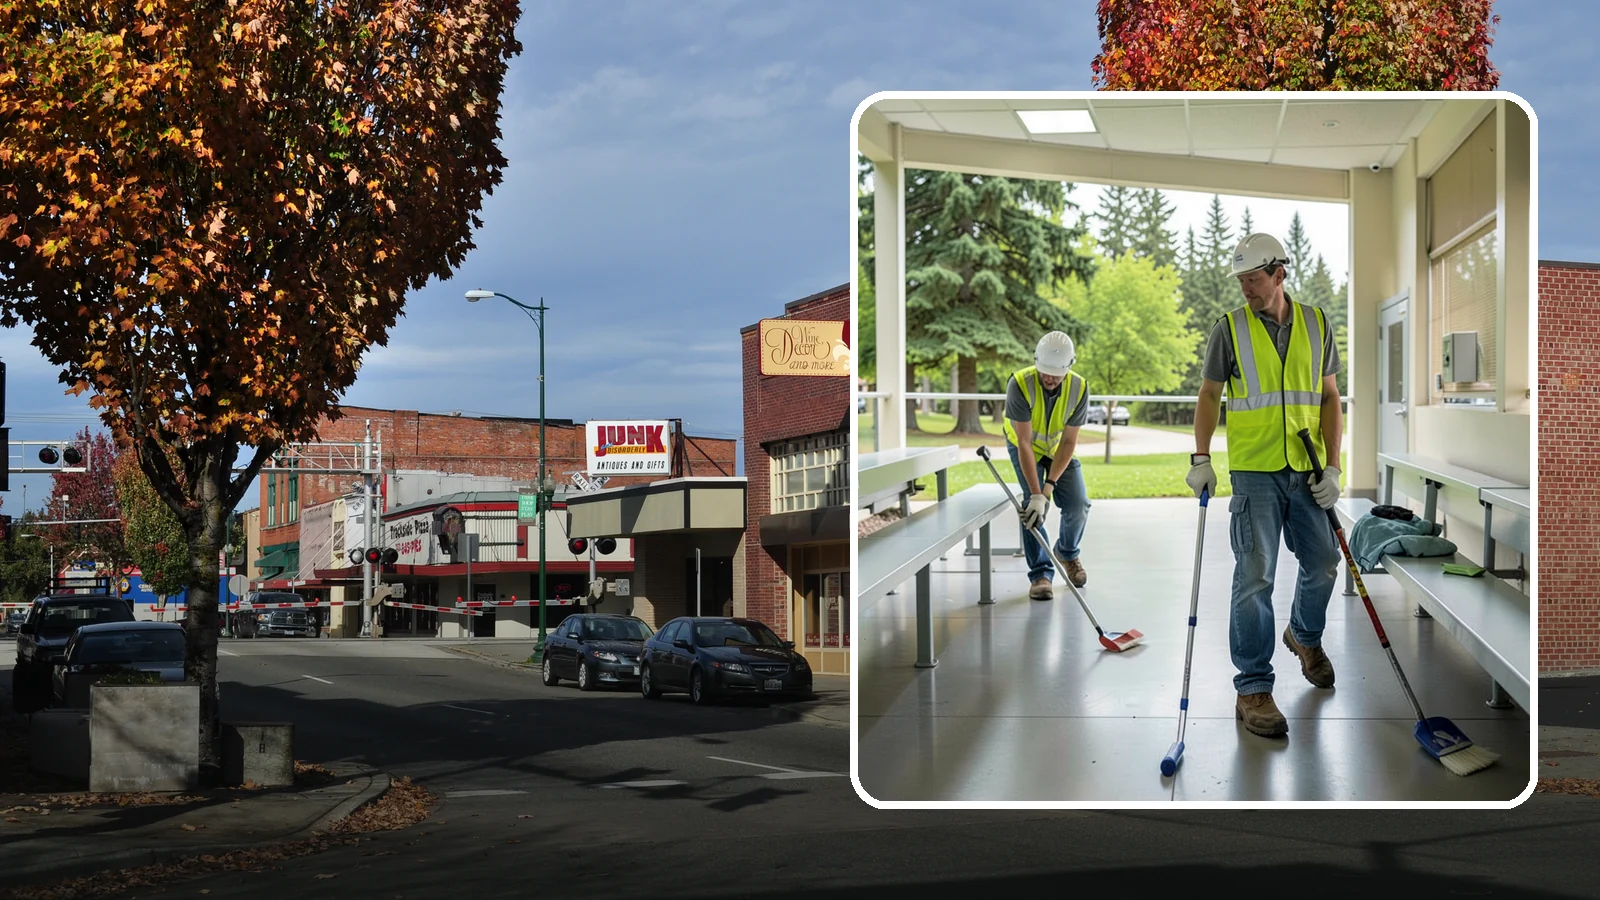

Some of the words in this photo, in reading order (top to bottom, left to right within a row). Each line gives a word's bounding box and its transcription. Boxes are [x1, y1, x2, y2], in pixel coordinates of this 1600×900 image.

[596, 425, 664, 457] JUNK
[607, 446, 646, 454] DISORDERLY
[596, 461, 628, 470] ANTIQUES
[631, 461, 644, 470] AND
[646, 460, 665, 470] GIFTS
[390, 523, 413, 539] Trackside
[414, 520, 429, 534] Pizza
